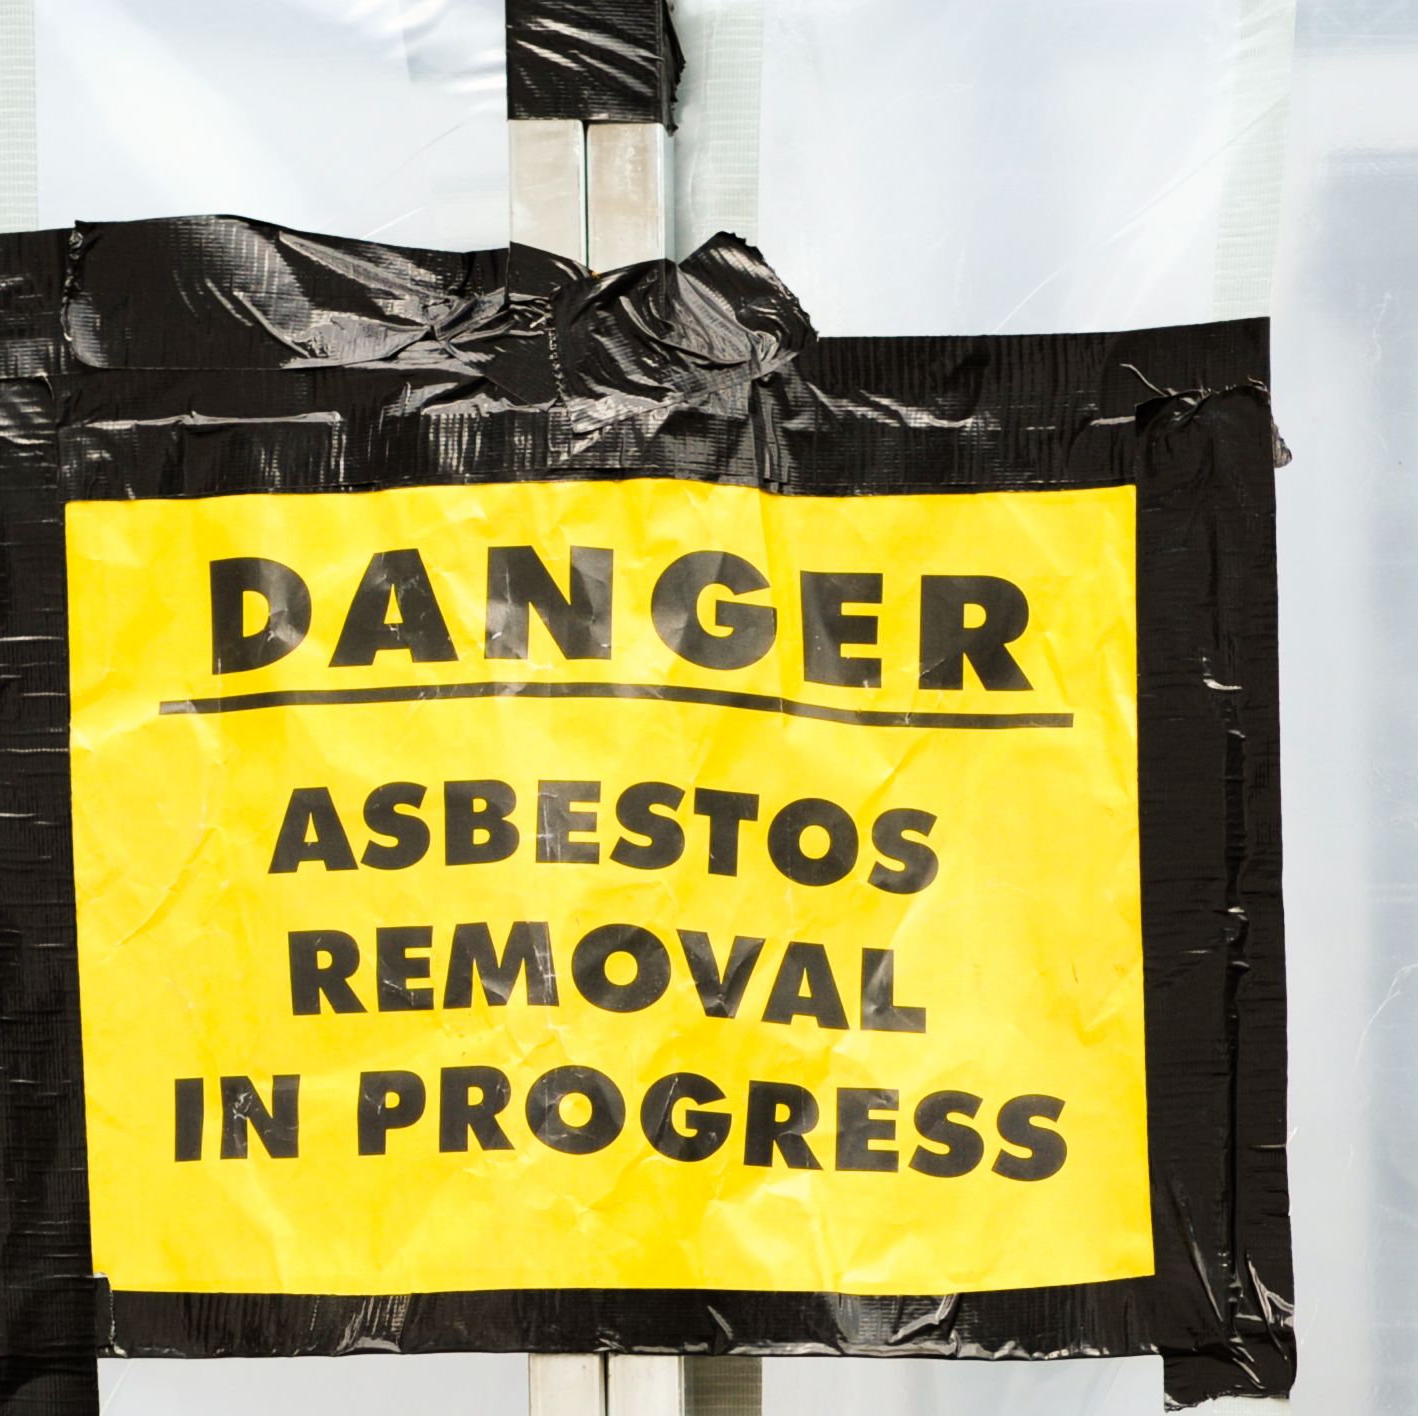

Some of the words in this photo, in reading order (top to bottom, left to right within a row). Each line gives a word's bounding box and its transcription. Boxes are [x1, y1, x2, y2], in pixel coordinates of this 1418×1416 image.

[208, 546, 1034, 693] DANGER
[268, 778, 939, 894] ASBESTOS
[288, 920, 927, 1035] REMOVAL
[173, 1074, 301, 1162] IN
[357, 1064, 1069, 1183] PROGRESS
